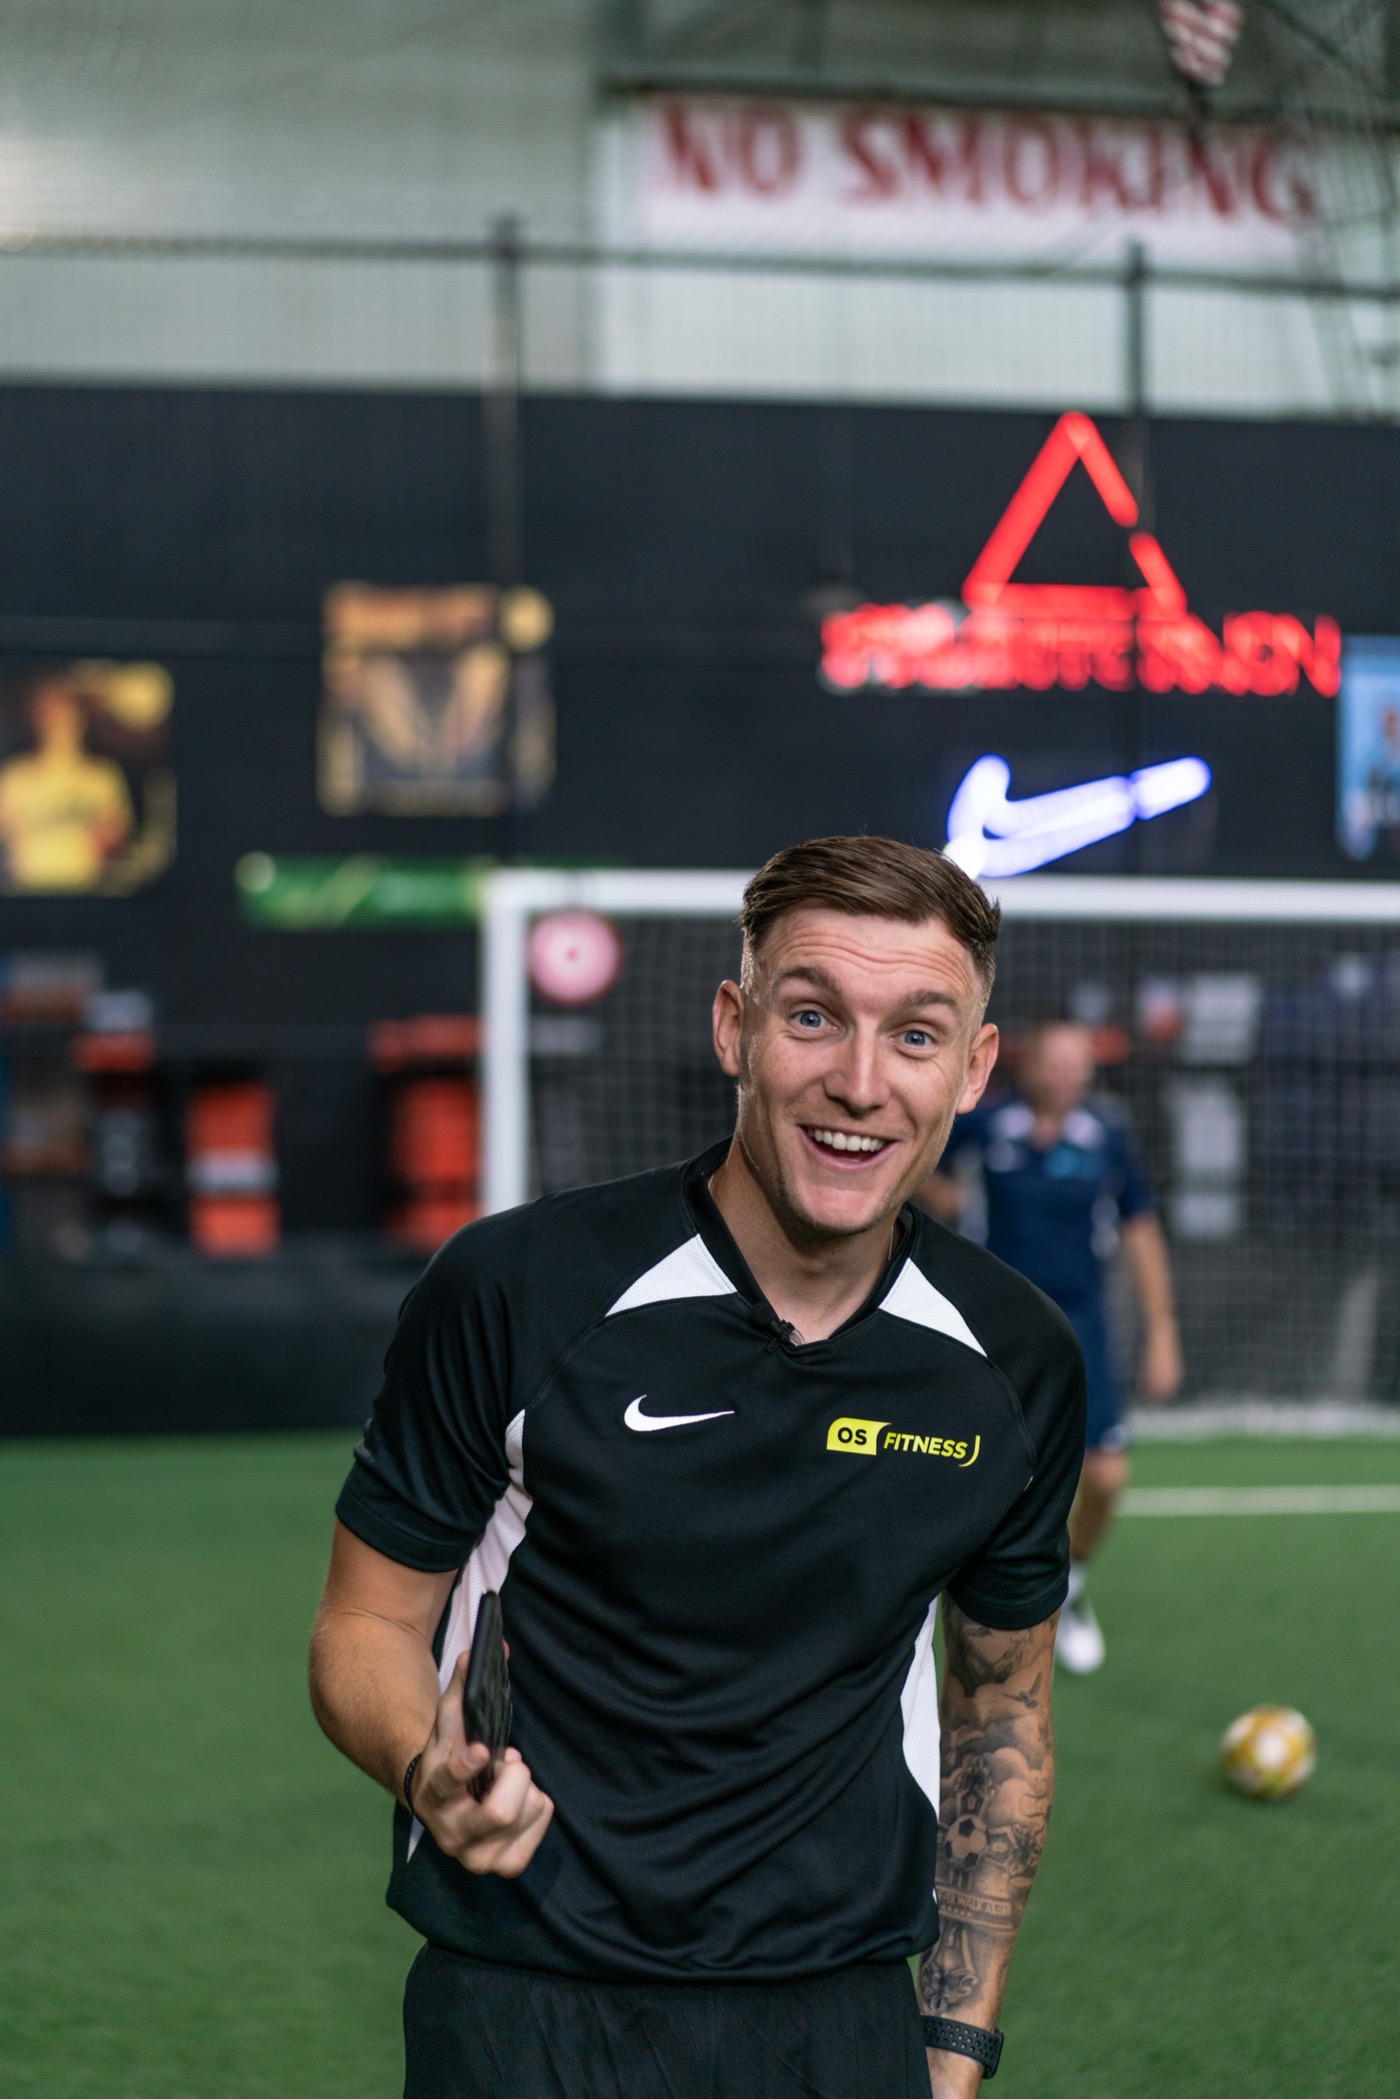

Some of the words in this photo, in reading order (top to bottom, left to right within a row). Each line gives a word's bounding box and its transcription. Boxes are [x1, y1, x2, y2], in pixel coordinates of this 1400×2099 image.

[655, 101, 804, 195] NO
[842, 106, 1320, 225] SMOKING
[837, 1427, 868, 1446] OS
[883, 1432, 968, 1459] FITNESS
